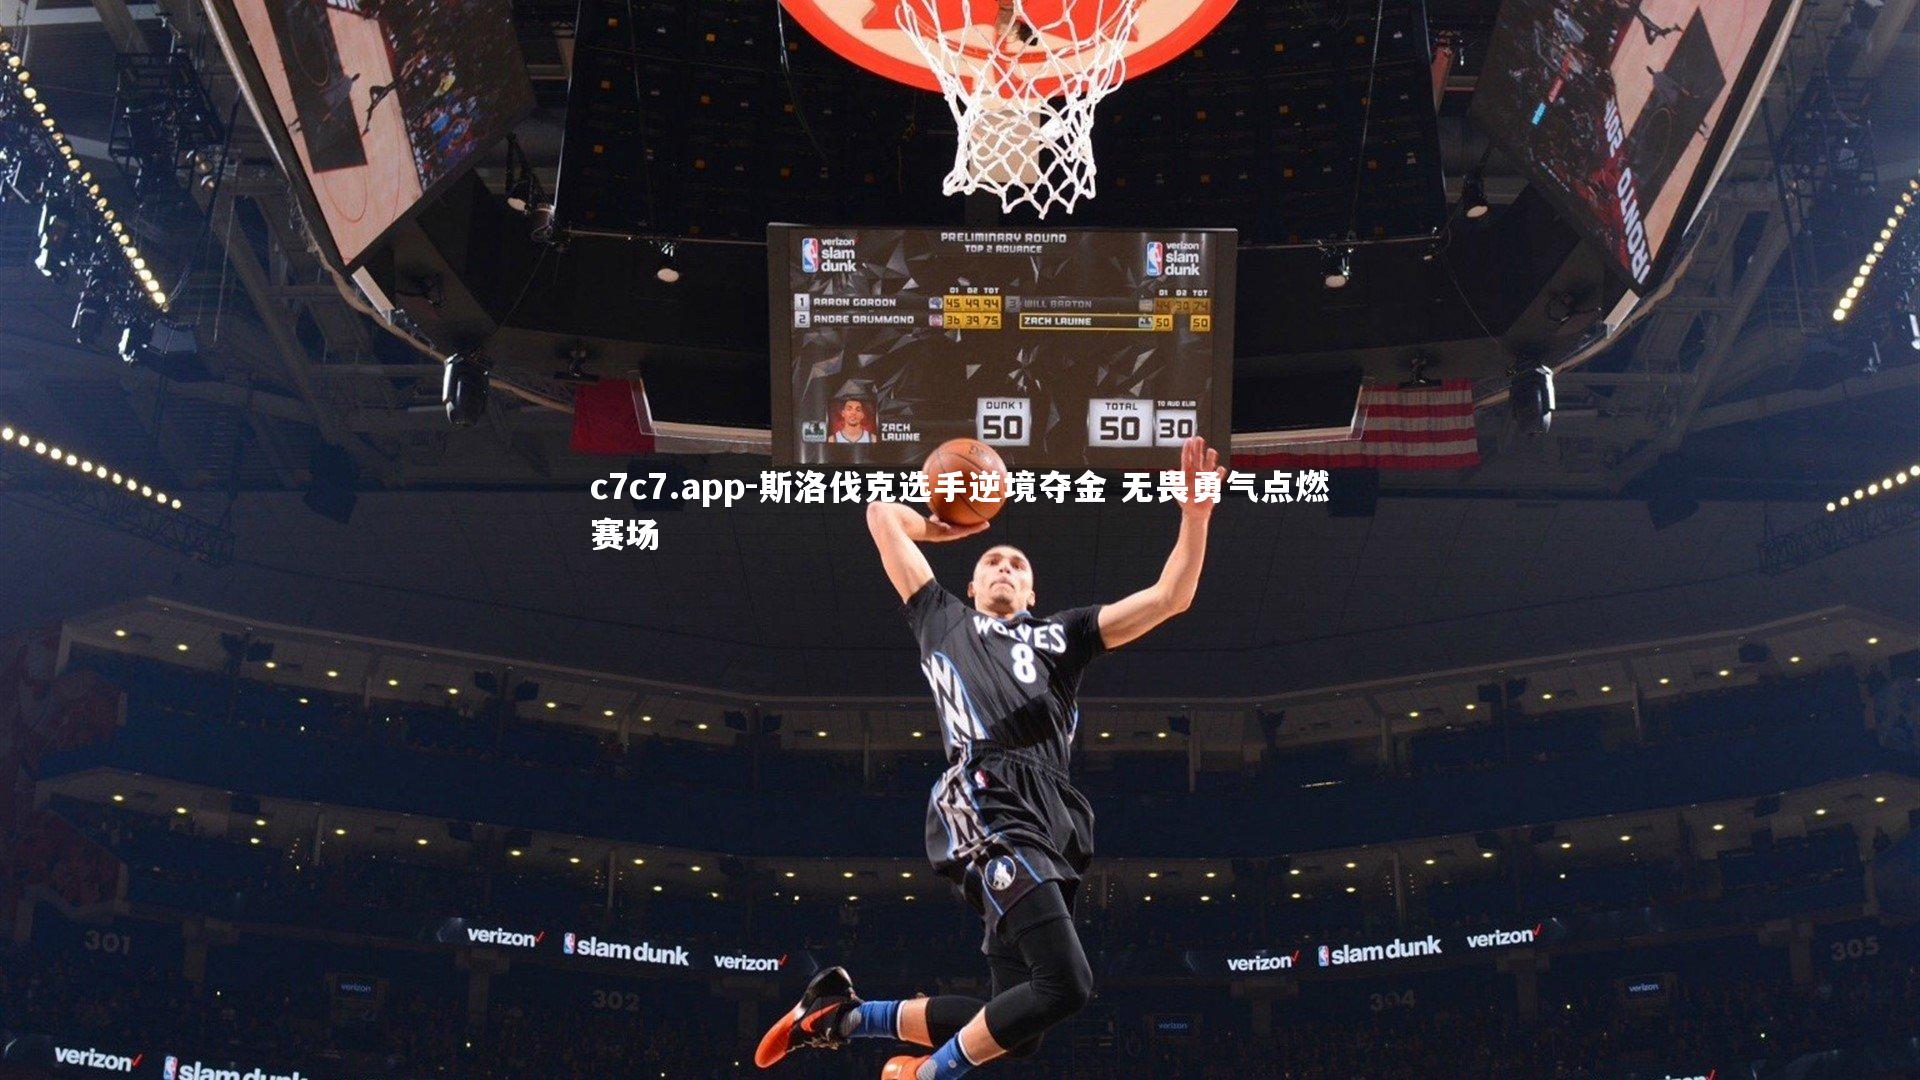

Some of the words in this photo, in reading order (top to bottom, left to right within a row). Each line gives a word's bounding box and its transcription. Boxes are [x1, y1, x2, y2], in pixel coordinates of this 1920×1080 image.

[821, 237, 855, 246] verizon
[941, 232, 1022, 243] PRELIMINARY
[1025, 233, 1067, 243] ROUND
[965, 244, 984, 253] TOP
[986, 244, 992, 253] 2
[1166, 240, 1200, 250] verizon
[821, 247, 856, 260] slam
[1165, 251, 1200, 263] slam
[820, 259, 857, 272] dunk
[1165, 263, 1200, 276] dunk
[813, 298, 850, 307] AARON
[852, 298, 897, 307] GORDON
[946, 299, 961, 308] 45
[965, 299, 980, 308] 49
[984, 299, 999, 308] 94
[813, 315, 850, 324] ANDRE
[852, 315, 914, 324] DRUMMOND
[965, 315, 980, 325] 39
[984, 315, 999, 325] 75
[1024, 317, 1051, 325] ZACH
[1054, 317, 1092, 325] LAVINE
[1156, 318, 1170, 328] 50
[1193, 318, 1208, 328] 50
[985, 401, 1015, 410] DUNK
[1105, 402, 1138, 411] TOTAL
[881, 423, 911, 432] ZACH
[983, 415, 1022, 440] 50
[1100, 416, 1140, 441] 50
[1159, 418, 1193, 438] 30
[881, 432, 921, 442] LAVINE
[973, 615, 1067, 654] WOLVES
[1011, 642, 1037, 684] 8
[85, 930, 131, 955] 301
[467, 927, 536, 948] verizon
[1466, 927, 1534, 949] verizon
[577, 936, 631, 960] slam
[632, 942, 690, 967] dunk
[1331, 944, 1385, 966] slam
[1385, 935, 1443, 960] dunk
[1831, 935, 1880, 962] 305
[714, 953, 779, 971] verizon
[1227, 951, 1292, 972] verizon
[1628, 981, 1660, 993] verizon
[54, 1046, 132, 1072] verizon
